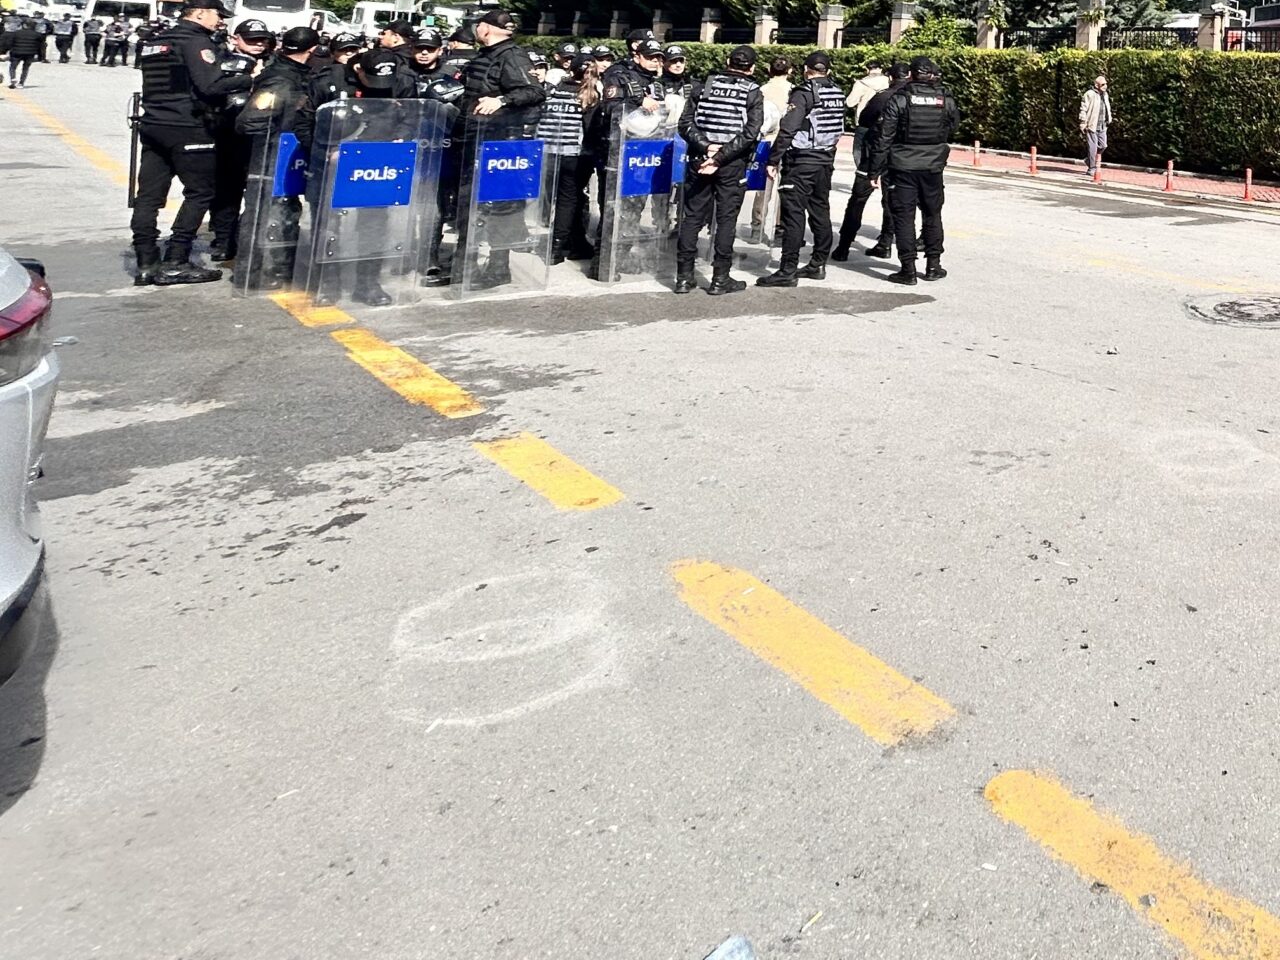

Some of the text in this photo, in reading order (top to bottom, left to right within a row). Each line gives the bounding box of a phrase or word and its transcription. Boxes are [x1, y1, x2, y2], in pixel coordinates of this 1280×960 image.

[547, 104, 576, 113] POLİS
[824, 98, 844, 109] POLİS
[487, 155, 529, 171] POLİS
[353, 166, 398, 181] POLİS
